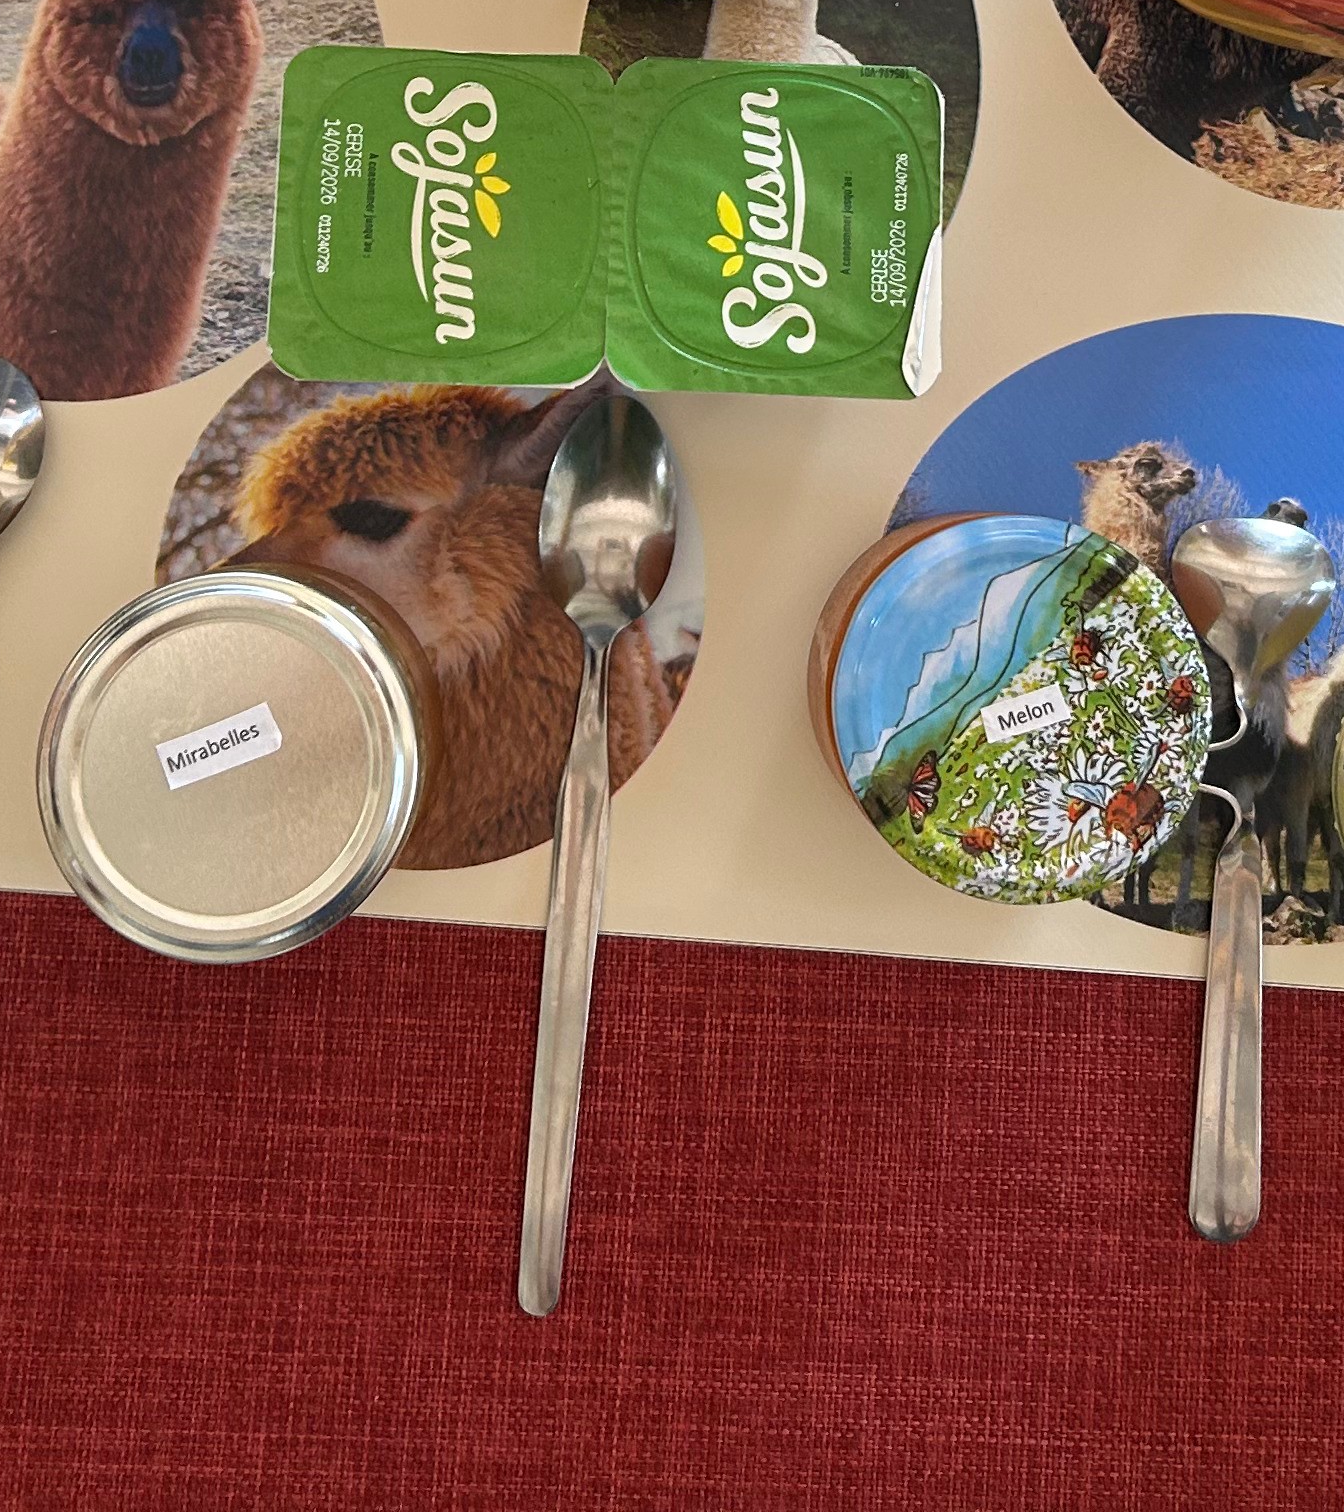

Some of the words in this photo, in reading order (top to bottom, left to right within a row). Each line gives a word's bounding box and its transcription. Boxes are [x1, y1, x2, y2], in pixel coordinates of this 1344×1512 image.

[320, 118, 341, 205] 14/09/2026
[344, 123, 364, 178] CERISE
[367, 161, 378, 212] consommer
[391, 77, 498, 344] Sojasun
[895, 153, 908, 212] 011240726
[316, 215, 332, 273] 011240726
[364, 213, 377, 252] jusqu'au
[722, 87, 828, 354] Sojasun
[871, 249, 888, 303] CERISE
[890, 219, 906, 308] 14/09/2026
[997, 701, 1055, 730] Melon
[166, 724, 260, 773] Mirabelles
